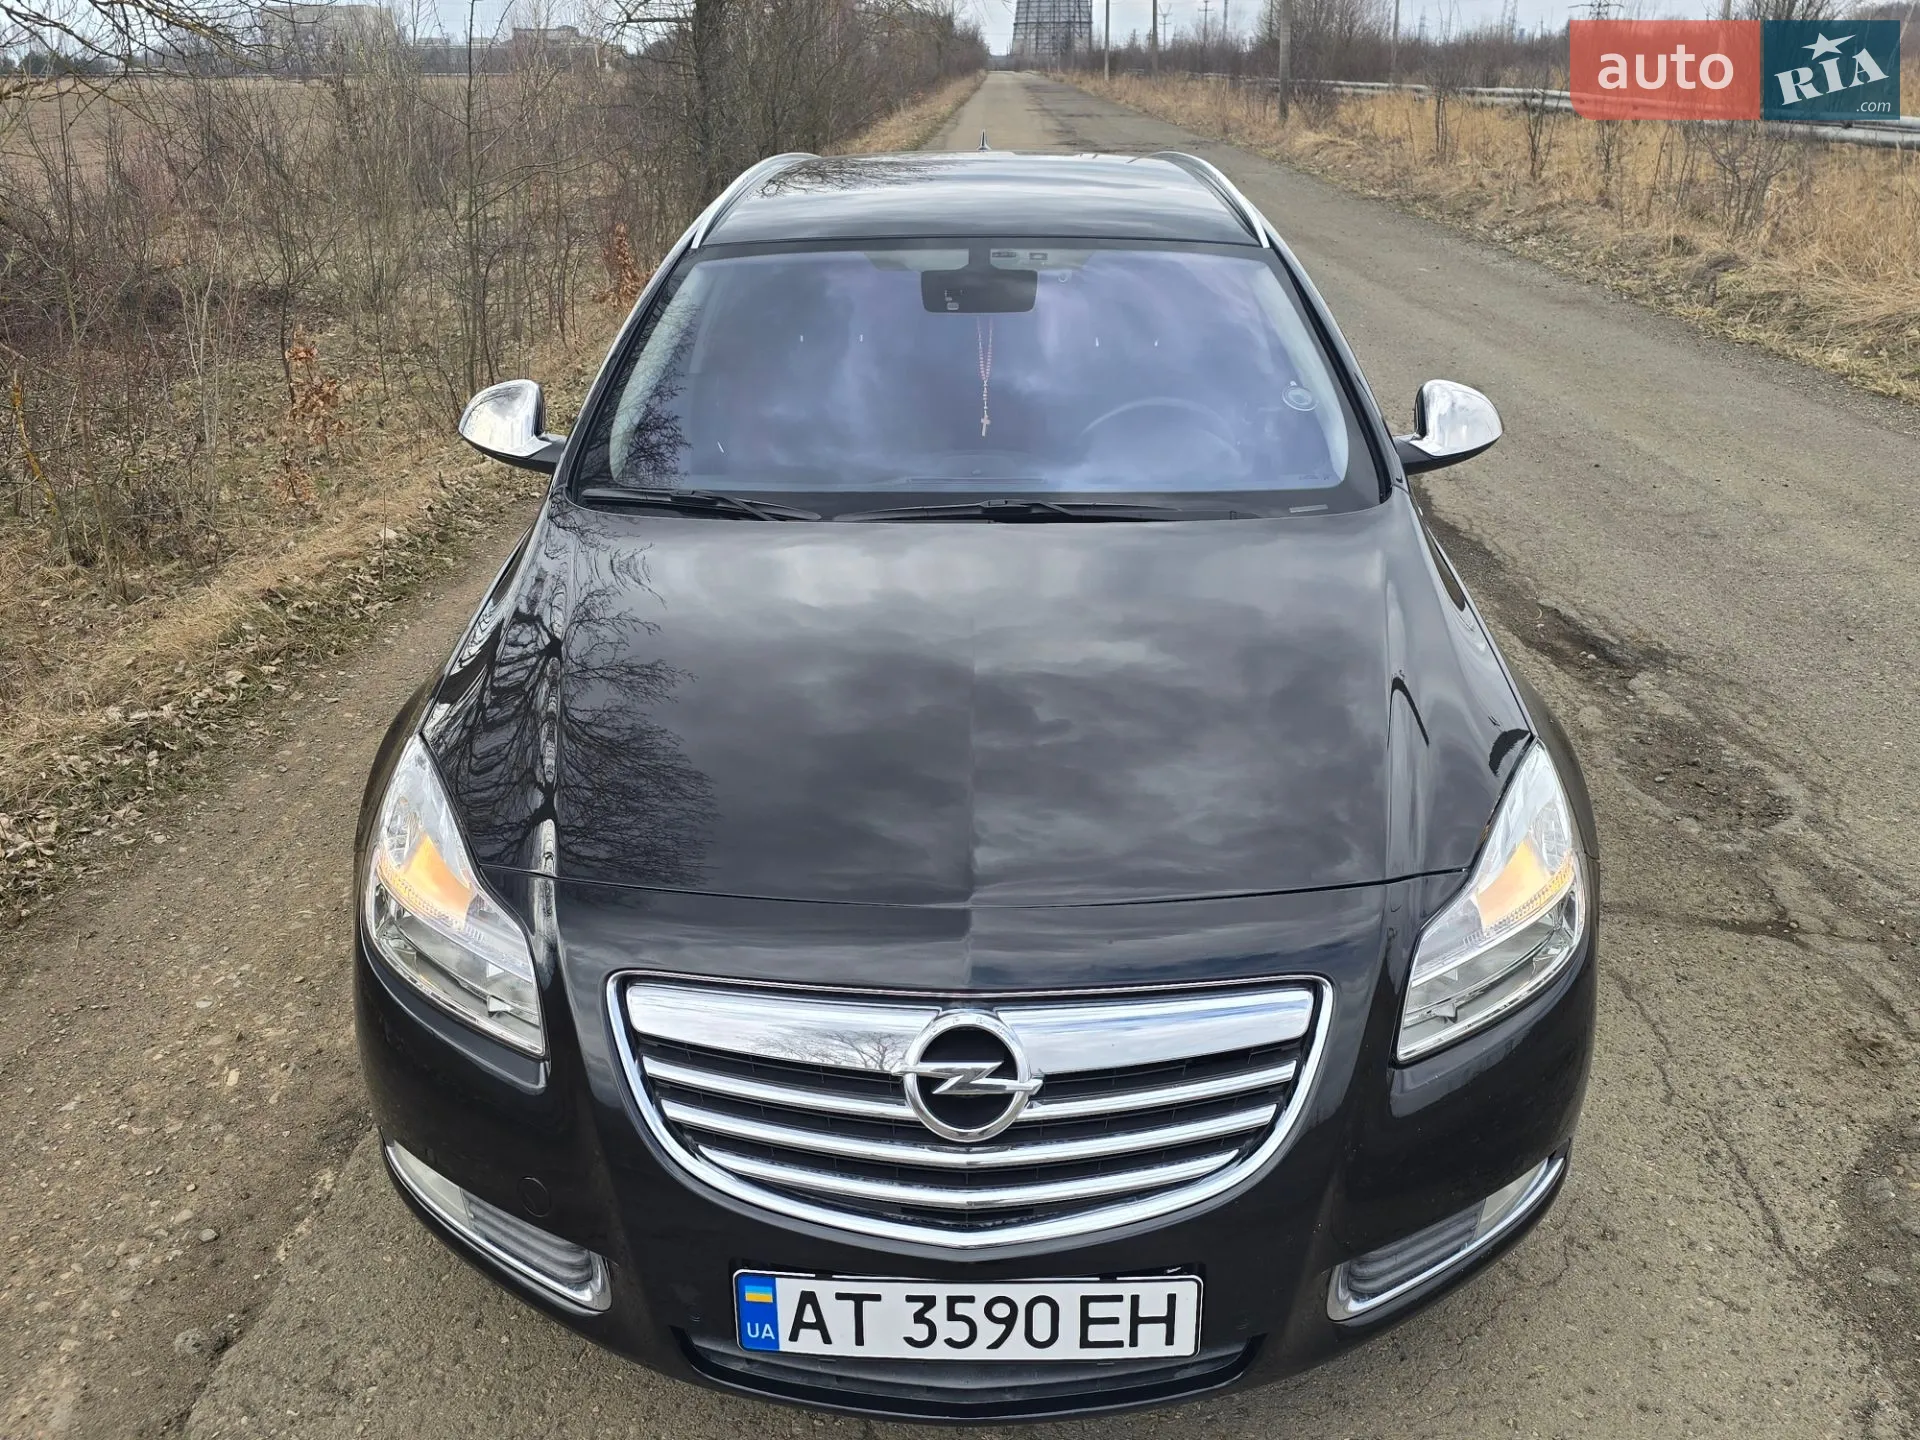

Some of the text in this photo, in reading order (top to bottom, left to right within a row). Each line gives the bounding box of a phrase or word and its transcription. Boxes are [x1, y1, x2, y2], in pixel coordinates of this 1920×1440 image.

[746, 1321, 775, 1340] UA
[788, 1290, 1177, 1350] AT 3590 EH
